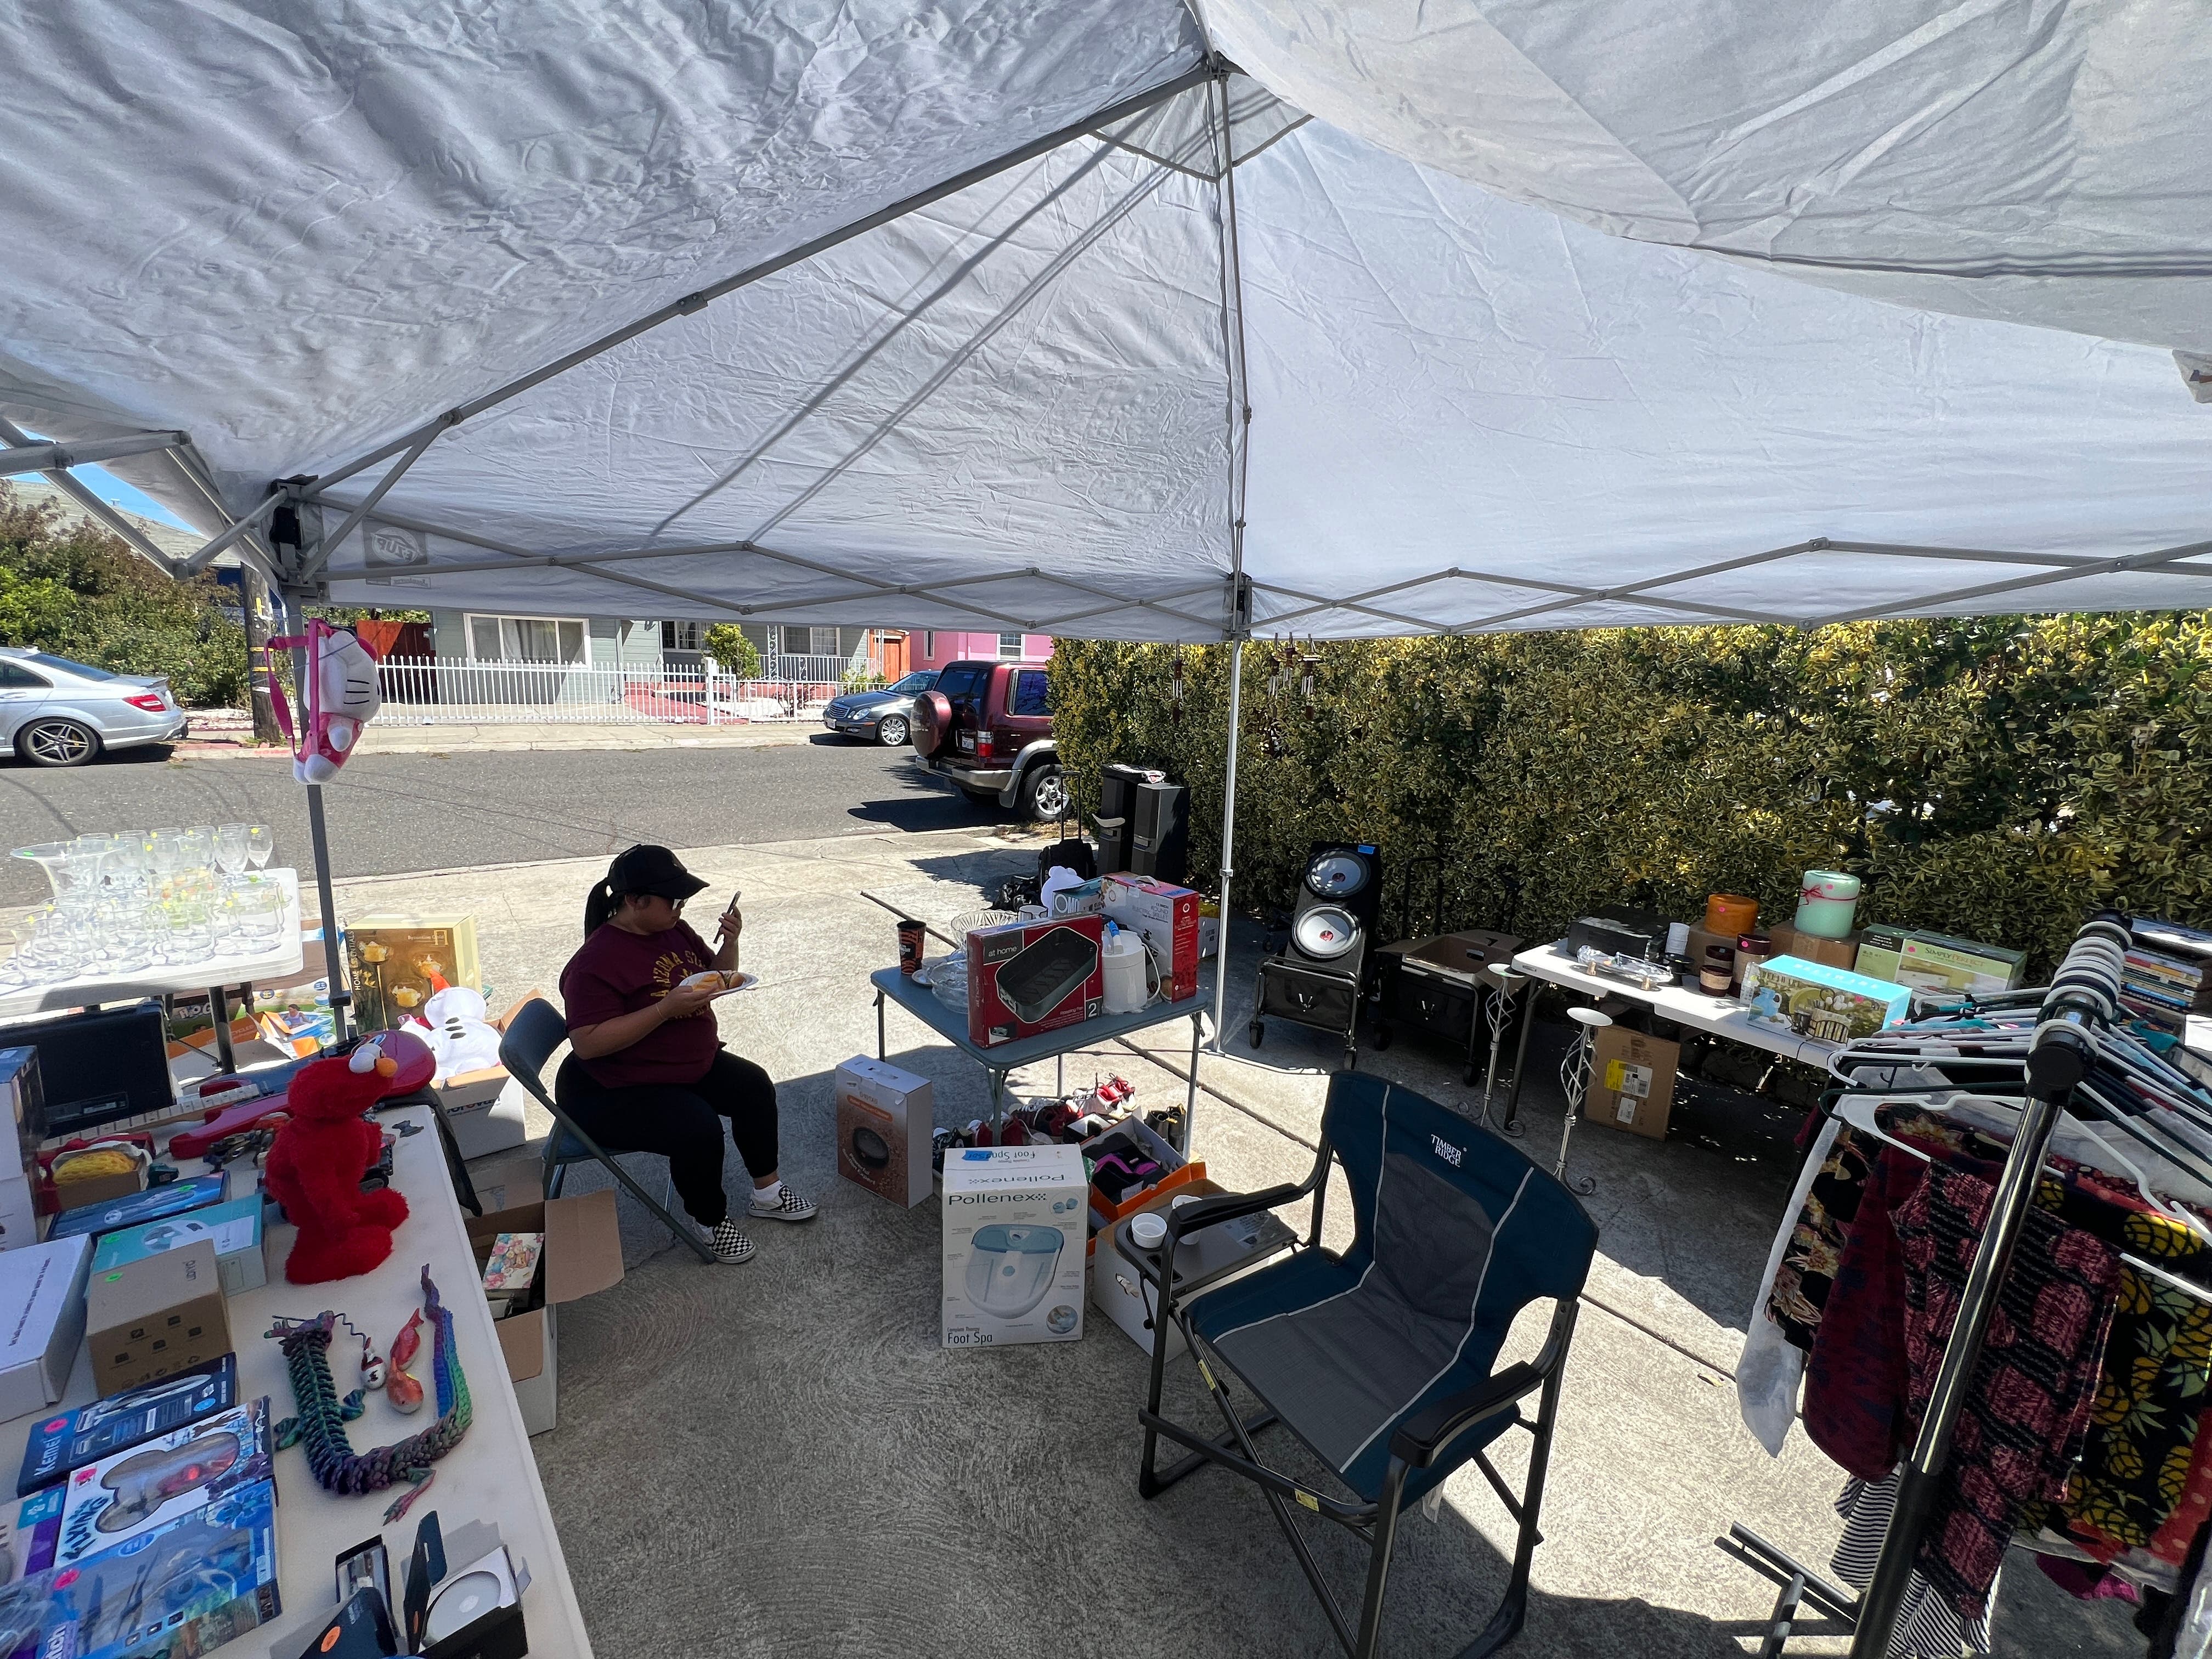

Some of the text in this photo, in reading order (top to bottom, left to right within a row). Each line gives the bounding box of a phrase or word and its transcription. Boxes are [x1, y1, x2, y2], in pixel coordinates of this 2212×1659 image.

[997, 946, 1017, 956] home
[1925, 947, 1952, 958] SIMPLY
[1088, 1002, 1097, 1017] 2
[1431, 1134, 1462, 1163] TIMBER
[1435, 1145, 1460, 1167] RIDGE
[980, 1174, 1064, 1183] Pollenex
[949, 1193, 1036, 1205] Pollenex
[947, 1332, 993, 1345] Foot Spa
